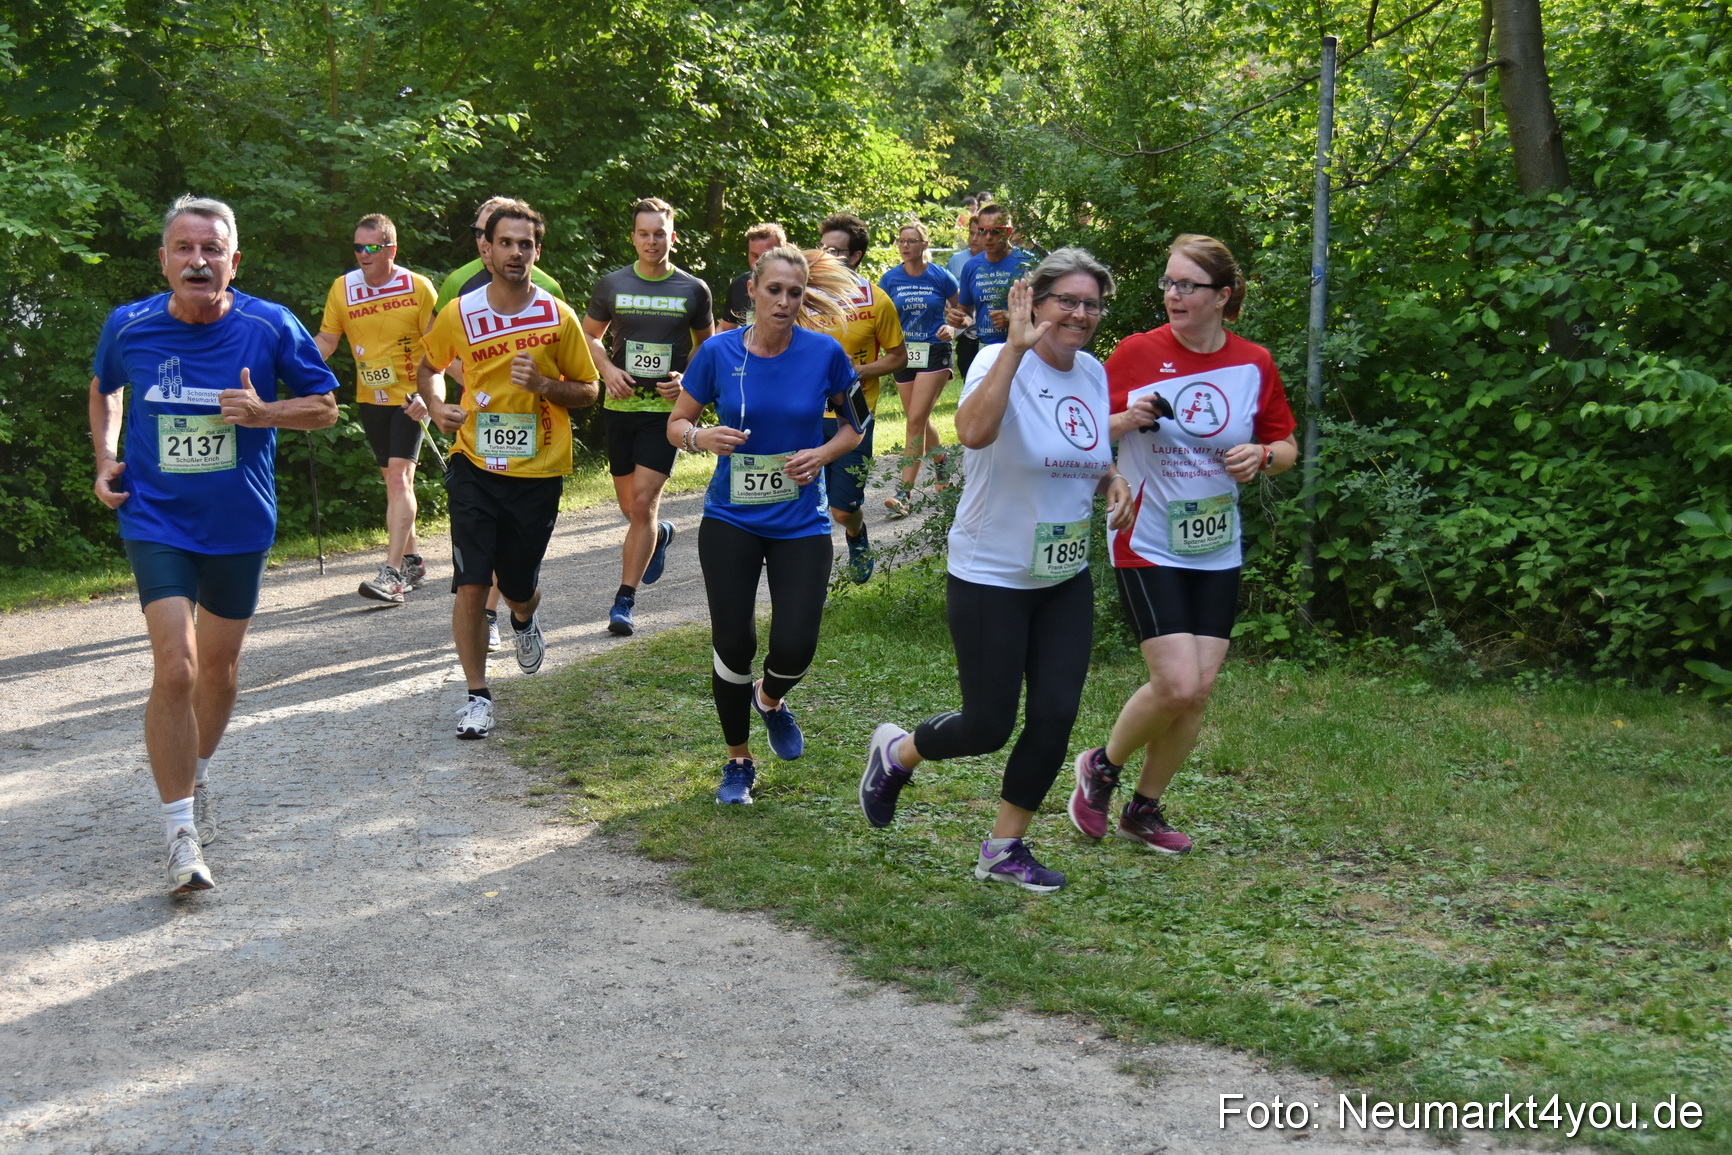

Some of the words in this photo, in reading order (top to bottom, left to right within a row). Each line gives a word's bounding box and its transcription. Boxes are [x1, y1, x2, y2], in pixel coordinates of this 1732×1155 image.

[348, 305, 378, 320] MAX
[382, 298, 417, 311] BÖGL
[615, 294, 687, 313] BOCK
[471, 342, 510, 363] MAX
[515, 333, 560, 351] BÖGL
[634, 354, 661, 369] 299
[360, 367, 391, 382] 1588
[167, 434, 226, 457] 2137
[483, 428, 528, 446] 1692
[744, 472, 782, 491] 576
[1178, 513, 1227, 539] 1904
[1043, 538, 1086, 564] 1895
